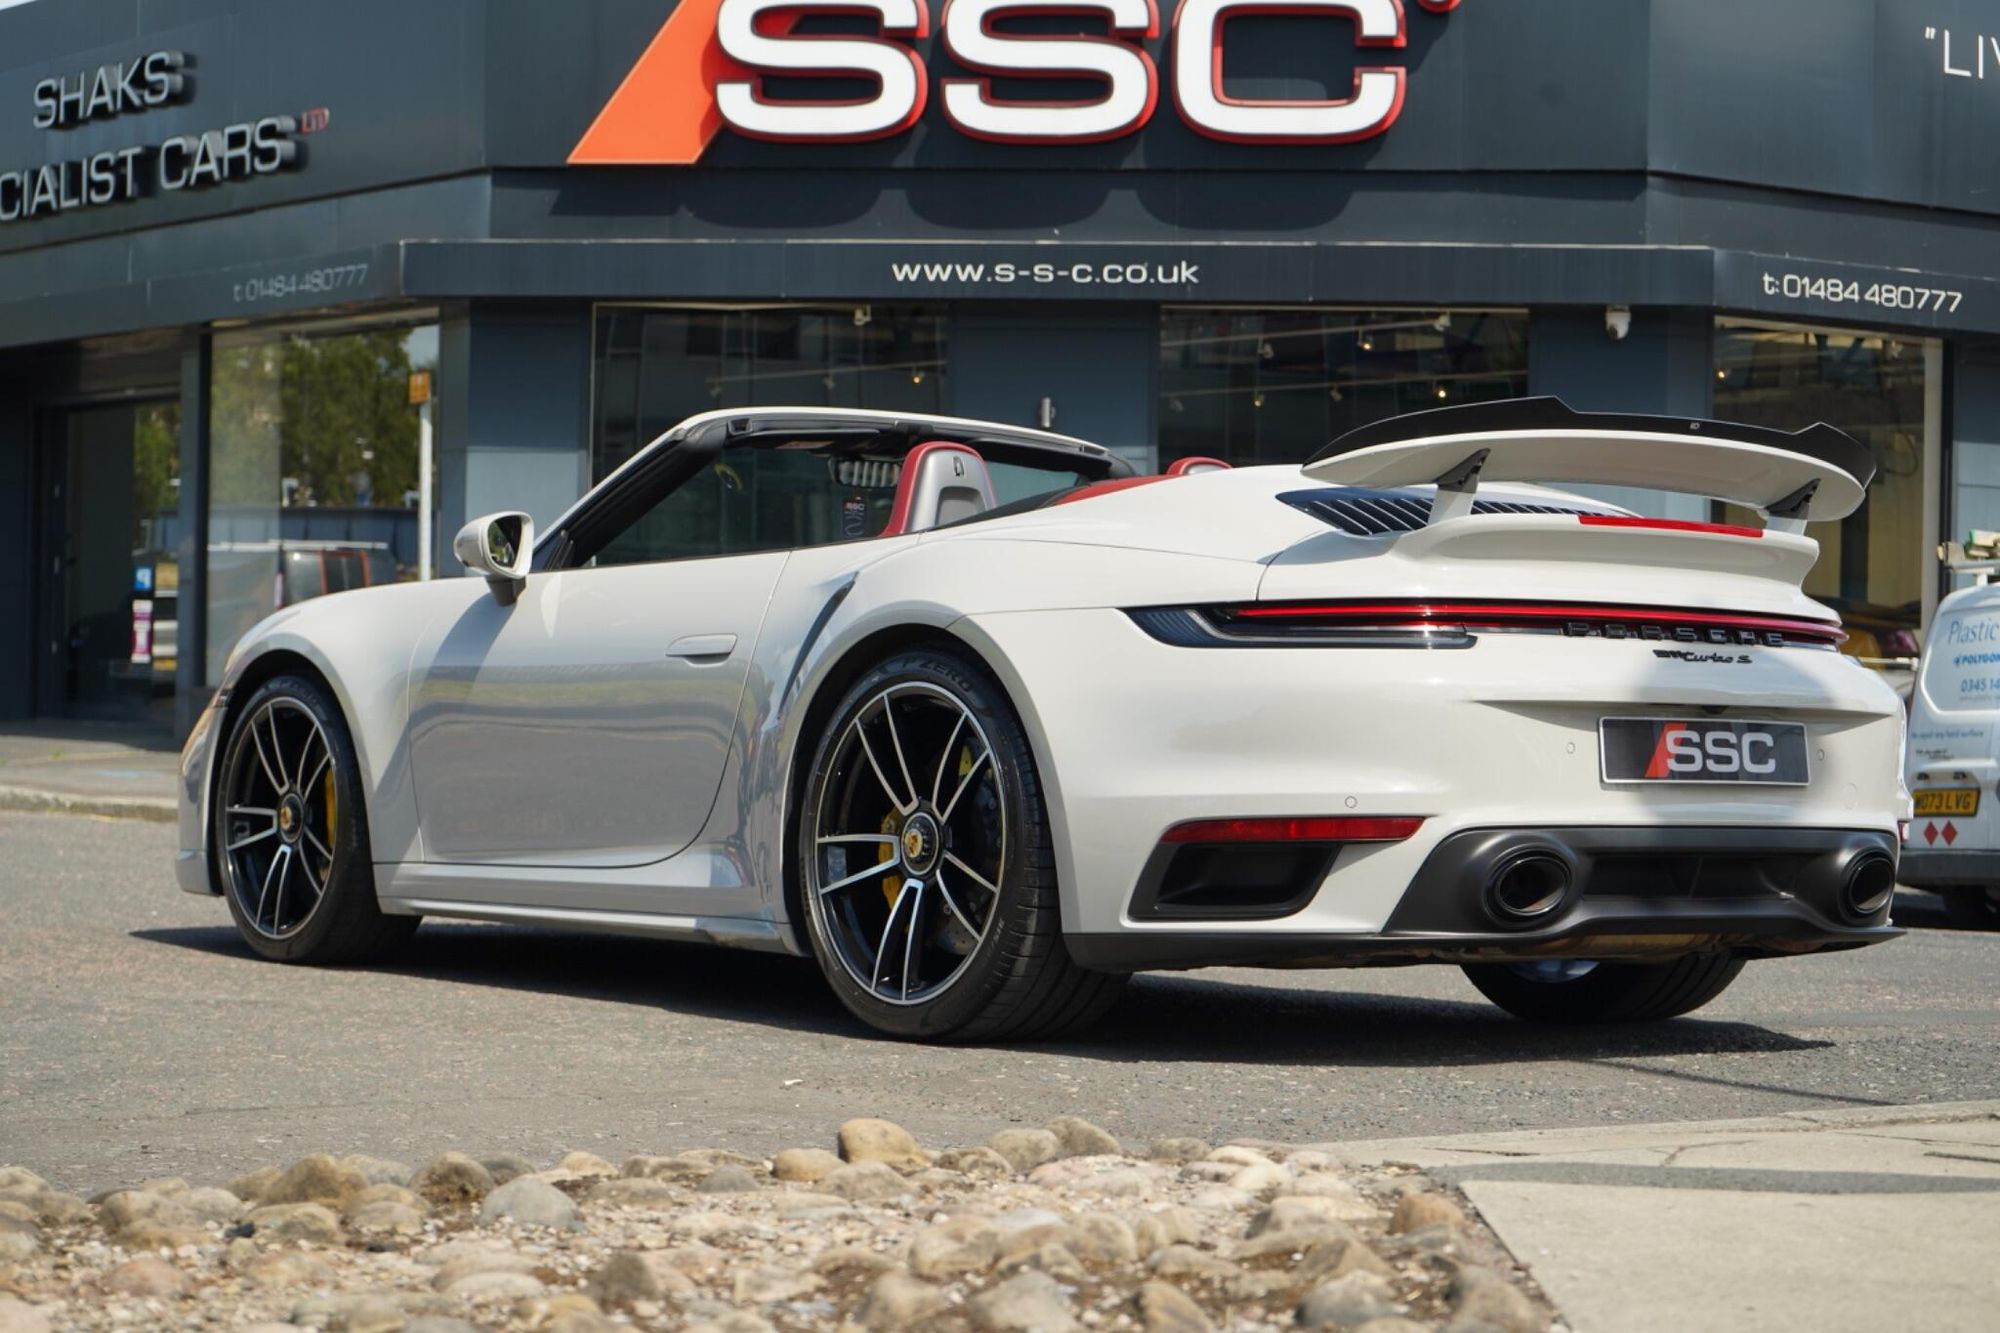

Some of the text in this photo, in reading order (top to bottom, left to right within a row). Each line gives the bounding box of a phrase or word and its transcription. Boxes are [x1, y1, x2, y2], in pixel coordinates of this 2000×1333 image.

[716, 0, 1406, 143] SSC
[33, 51, 173, 128] SHAKS
[0, 107, 330, 221] CIALIST CARS LTD
[892, 260, 1199, 284] www.s-s-c.co.uk
[1864, 283, 1963, 313] 480777
[1566, 621, 1785, 648] PORSCHE
[1947, 617, 2000, 645] Plastic
[1961, 679, 1986, 692] 0345
[1665, 729, 1777, 774] SSC
